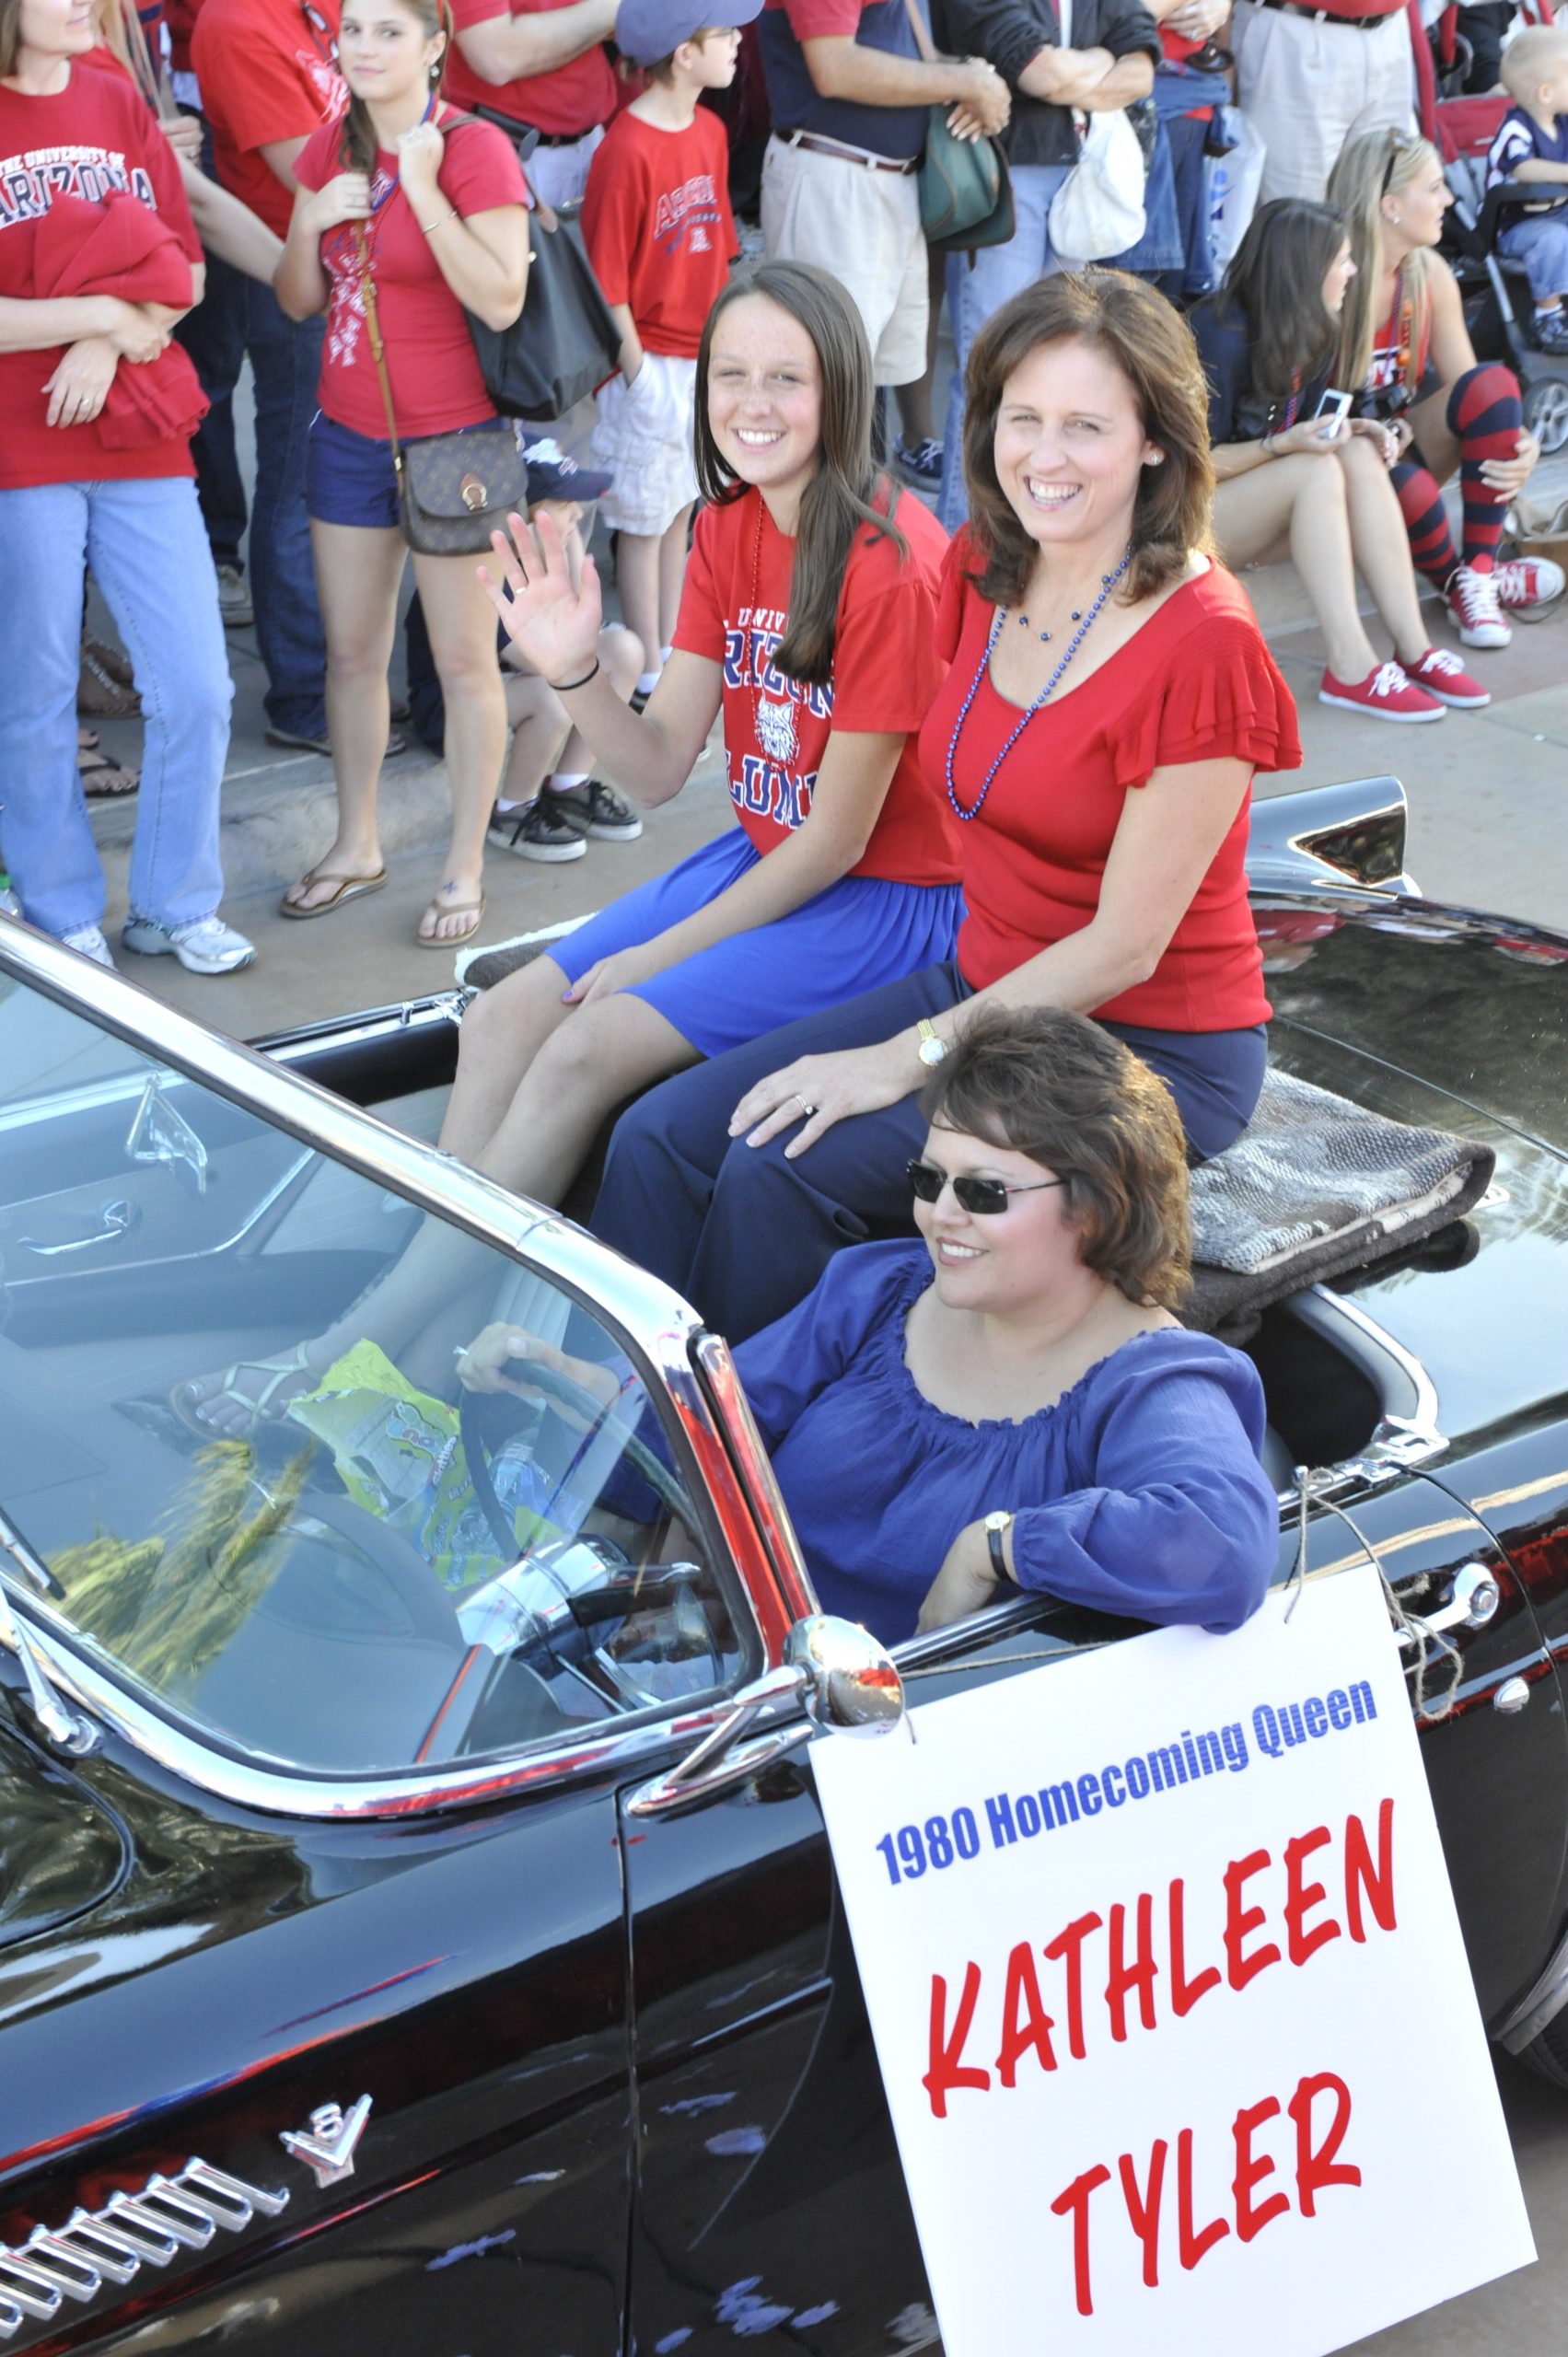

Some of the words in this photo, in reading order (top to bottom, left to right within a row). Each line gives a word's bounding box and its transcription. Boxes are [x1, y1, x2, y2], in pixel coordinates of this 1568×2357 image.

[737, 608, 785, 632] UNIV
[877, 1805, 981, 1886] 1980
[984, 1723, 1250, 1849] Homecoming
[1253, 1679, 1377, 1759] Queen
[922, 1797, 1397, 2118] KATHLEEN
[1051, 2072, 1362, 2316] TYLER
